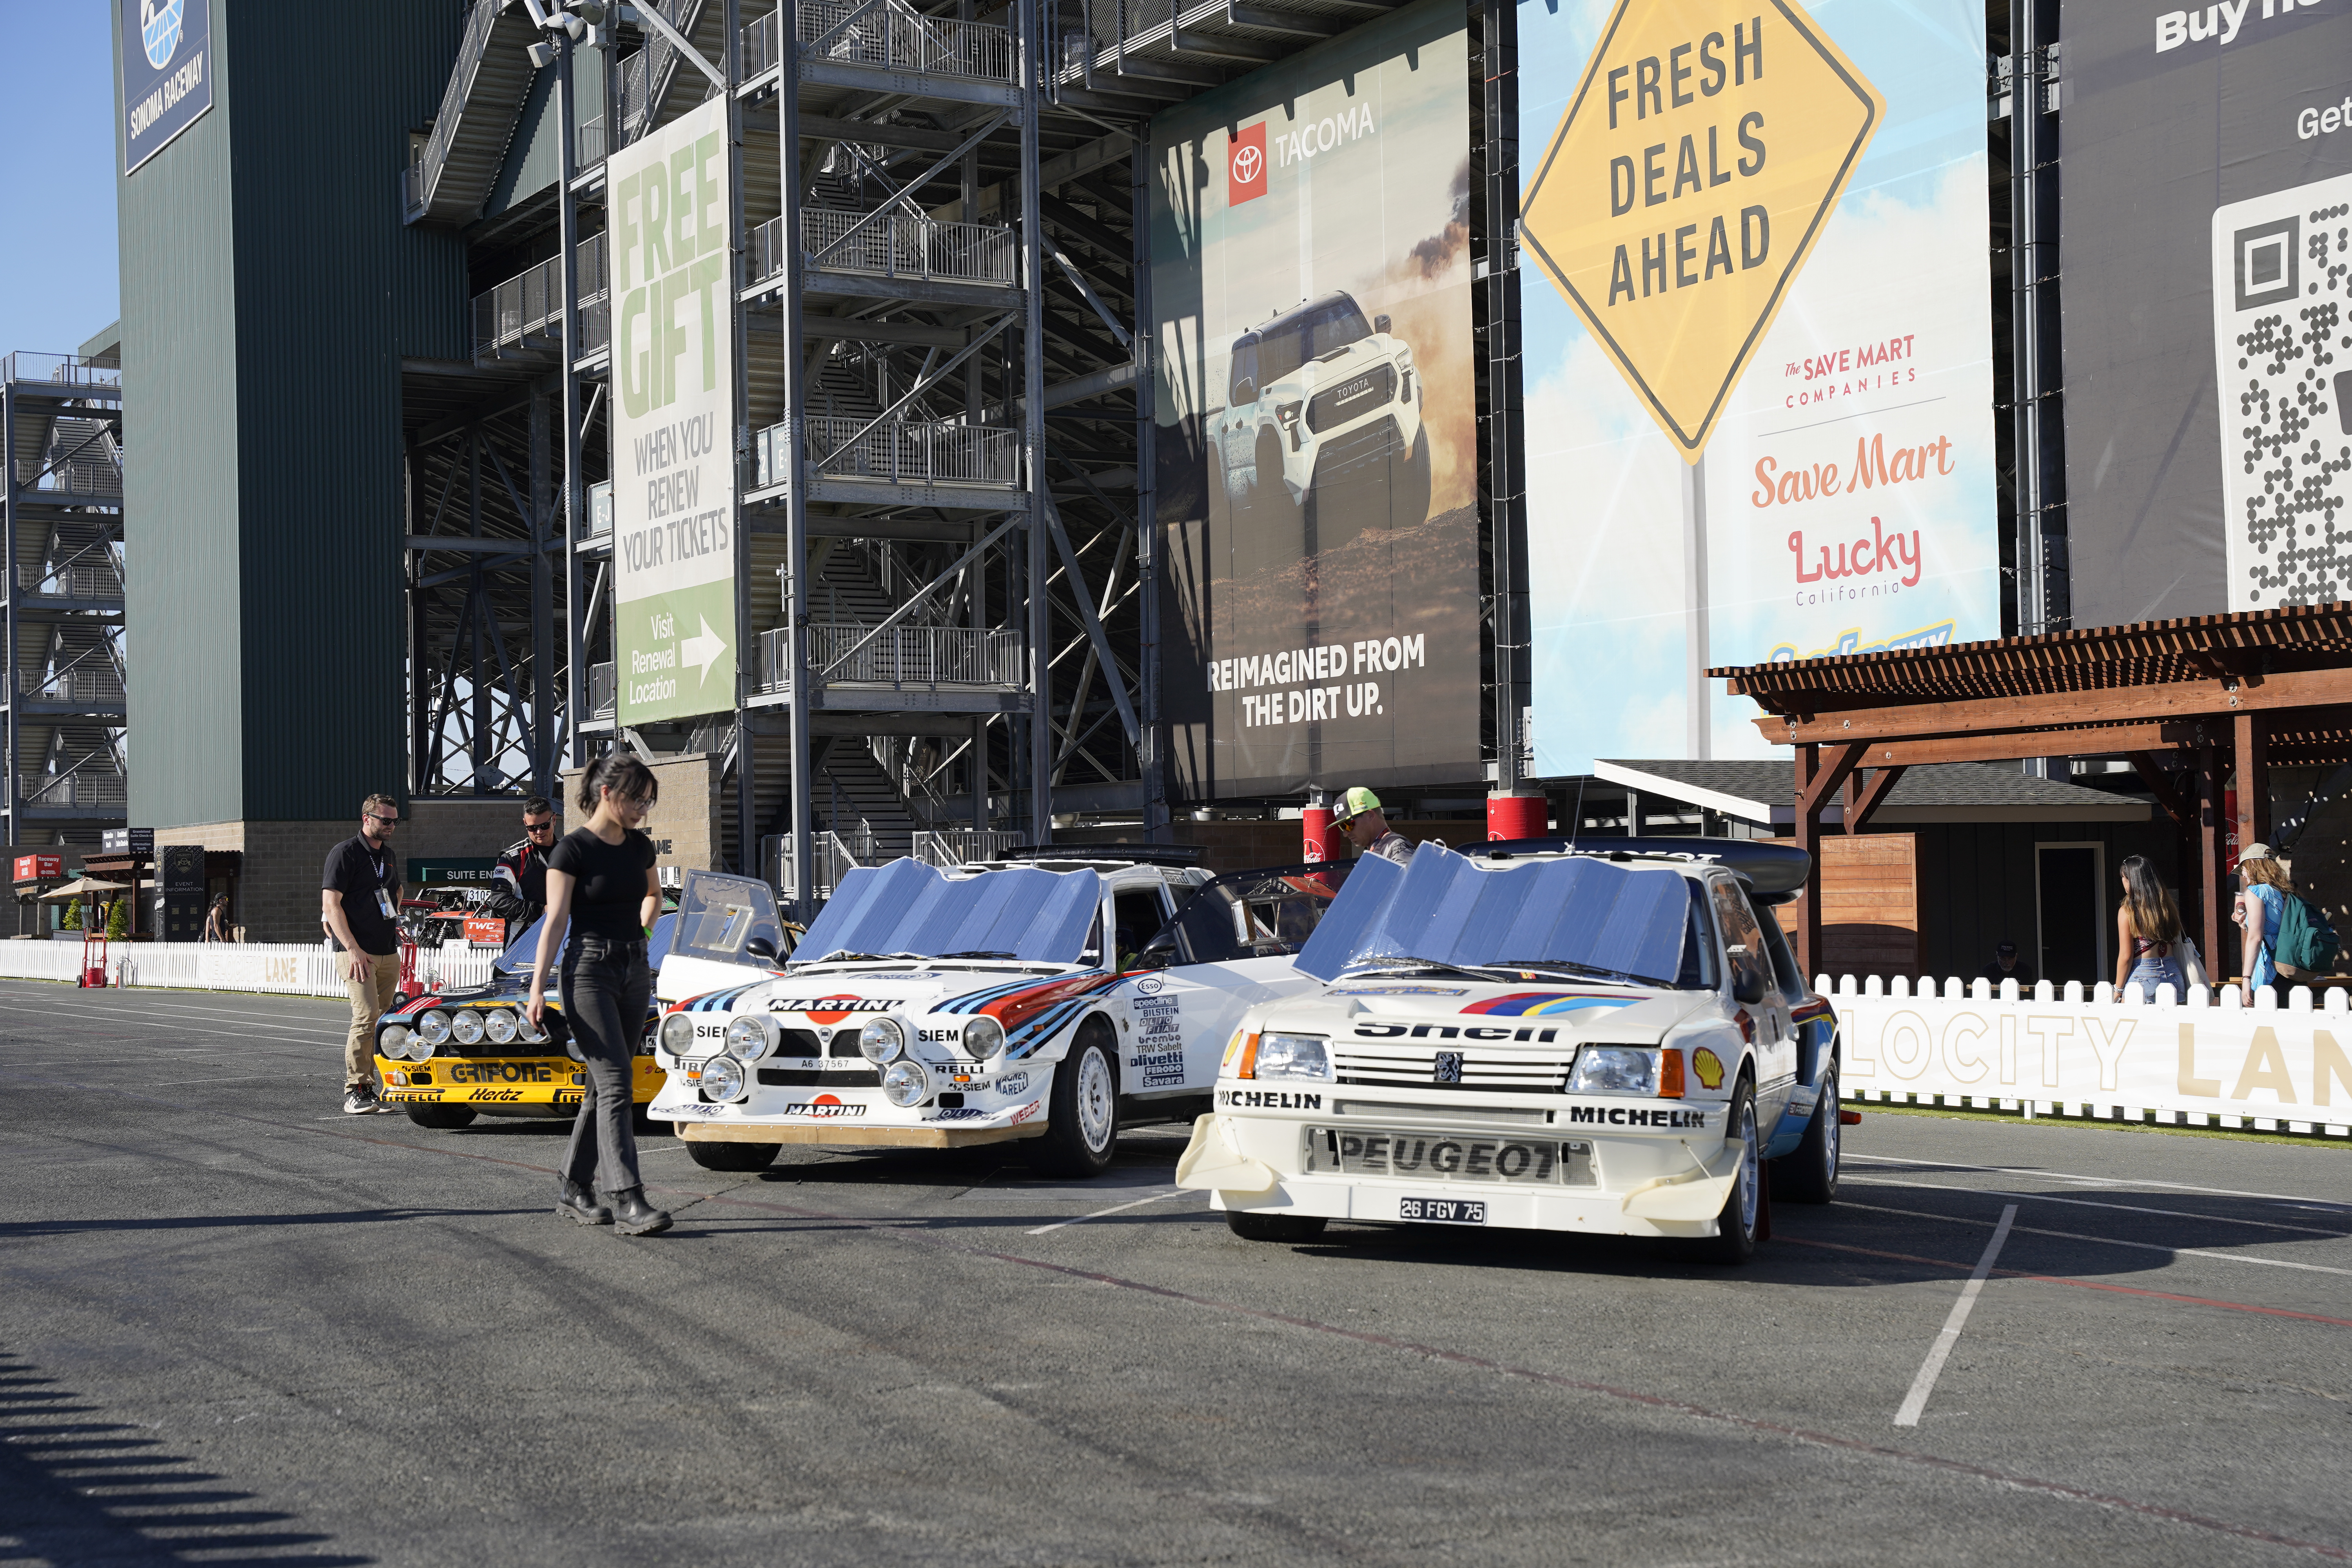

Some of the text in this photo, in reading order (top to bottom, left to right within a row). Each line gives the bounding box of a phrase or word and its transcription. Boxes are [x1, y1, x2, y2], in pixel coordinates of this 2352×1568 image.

[2156, 0, 2250, 54] Buy
[1608, 16, 1762, 130] FRESH
[131, 51, 203, 140] SONOMA RACEWAY
[1276, 102, 1375, 168] TACOMA
[1610, 111, 1766, 218] DEALS
[617, 129, 722, 292] FREE
[1608, 205, 1769, 307] AHEAD
[621, 252, 722, 419] GIFT
[1785, 334, 1915, 380] The SAVE MART
[1337, 378, 1369, 399] TOYOTA
[1786, 368, 1915, 408] COMPANIES
[634, 414, 713, 476] WHEN YOU
[761, 455, 766, 474] 2
[1752, 433, 1955, 508] Save Mart
[648, 465, 699, 520] RENEW
[623, 507, 728, 573] YOUR TICKETS
[1788, 516, 1921, 587] Lucky
[1797, 581, 1899, 606] California
[651, 613, 673, 640] Visit
[632, 641, 675, 675] Renewal
[1207, 633, 1425, 692] REIMAGINED FROM
[630, 678, 676, 705] Location
[1242, 682, 1383, 727] THE DIRT UP.
[447, 871, 475, 879] SUITE
[206, 955, 297, 983] VELOCITY LANE
[1134, 997, 1172, 1009] speedline
[1143, 1007, 1179, 1017] BILSTEIN
[1140, 1017, 1172, 1026] OLIO
[1147, 1025, 1179, 1034] FIAT
[1354, 1022, 1560, 1043] Shell
[918, 1030, 958, 1041] SIEM
[1136, 1042, 1182, 1054] TRW Sabelt
[1138, 1034, 1181, 1044] brembo
[1131, 1052, 1183, 1067] olivetti
[1146, 1064, 1182, 1074] FERODO
[451, 1062, 552, 1083] GRIFONE
[1144, 1076, 1183, 1087] Savara
[382, 1087, 445, 1101] PIRELLI
[468, 1089, 524, 1101] Hertz
[963, 1081, 990, 1091] SIEM
[789, 1105, 864, 1116] MARTINI
[1010, 1100, 1040, 1125] WEBER
[1571, 1107, 1705, 1128] MICHELIN
[1327, 1130, 1569, 1179] PEUGEOT
[1401, 1200, 1484, 1221] 26 FGV 75
